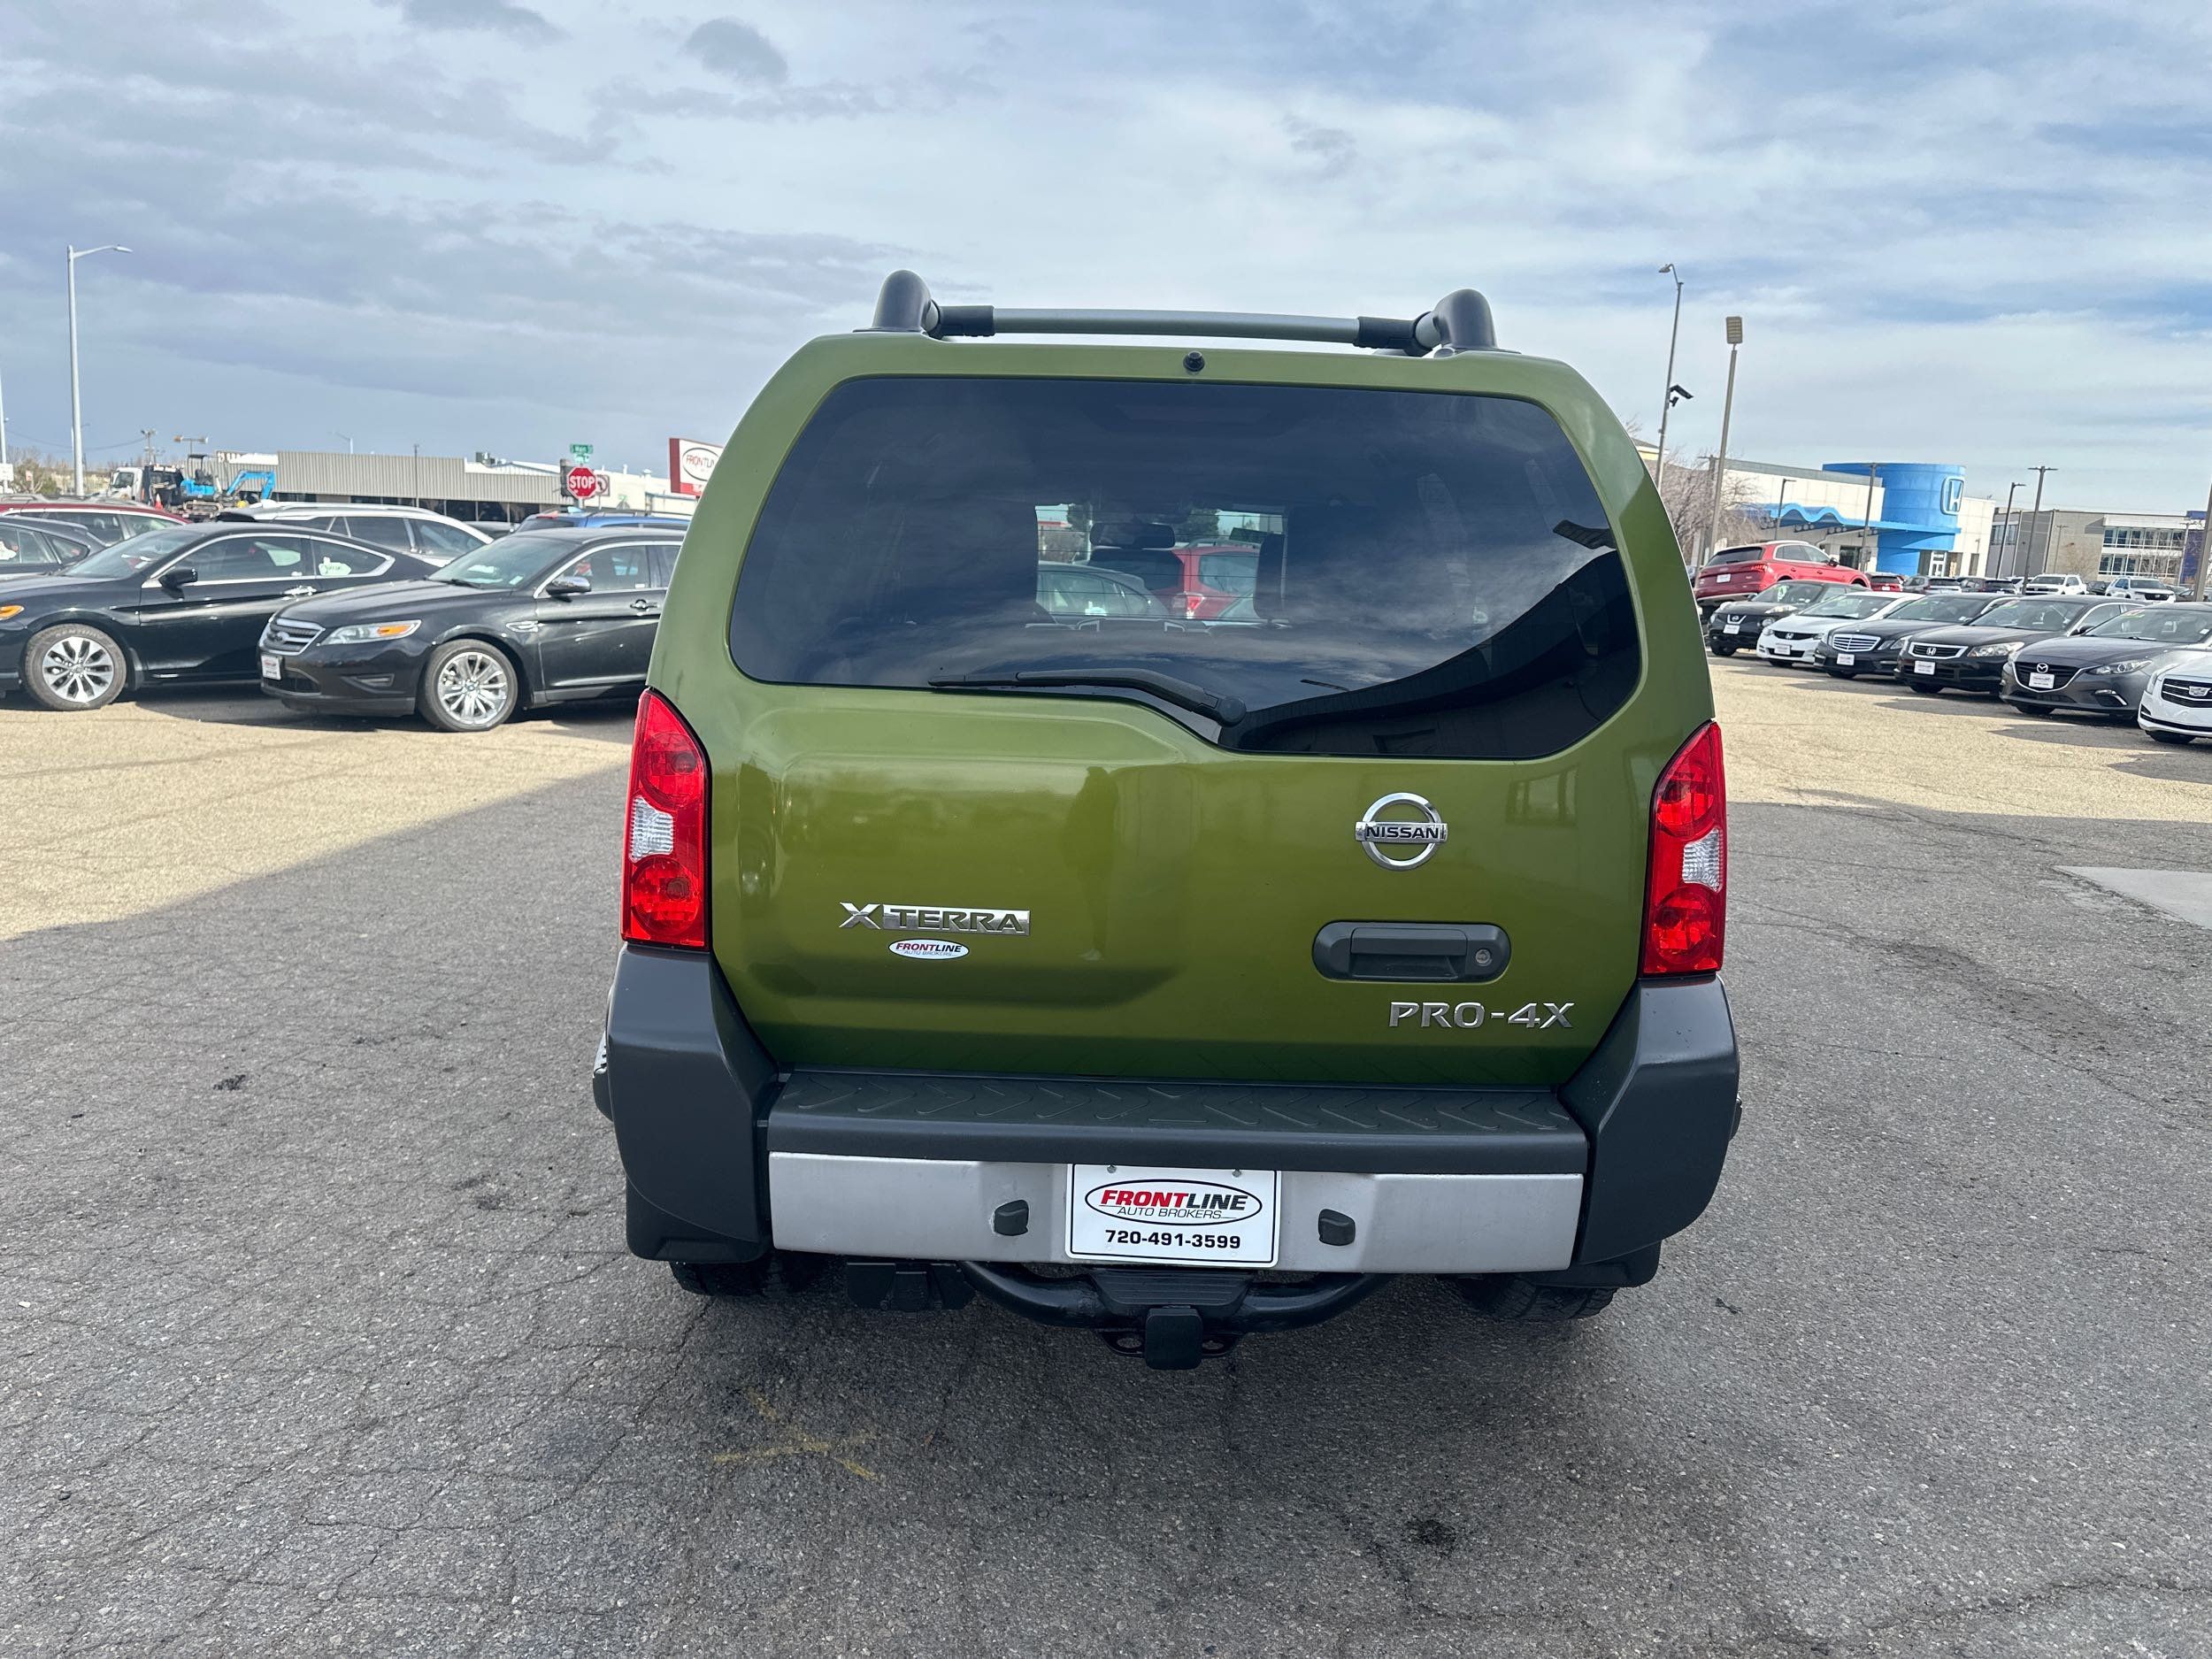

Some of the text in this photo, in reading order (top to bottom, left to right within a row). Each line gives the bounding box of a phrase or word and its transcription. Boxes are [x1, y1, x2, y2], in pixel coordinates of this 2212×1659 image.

[570, 475, 595, 489] STOP
[1365, 824, 1440, 840] NISSAN
[839, 902, 1027, 934] XTERRA
[895, 942, 963, 953] FRONTLINE
[1388, 1001, 1575, 1029] PRO-4X
[1100, 1189, 1248, 1211] FRONTLINE
[1117, 1205, 1223, 1220] AUTO BROKERS
[1105, 1229, 1240, 1249] 720-491-3599
